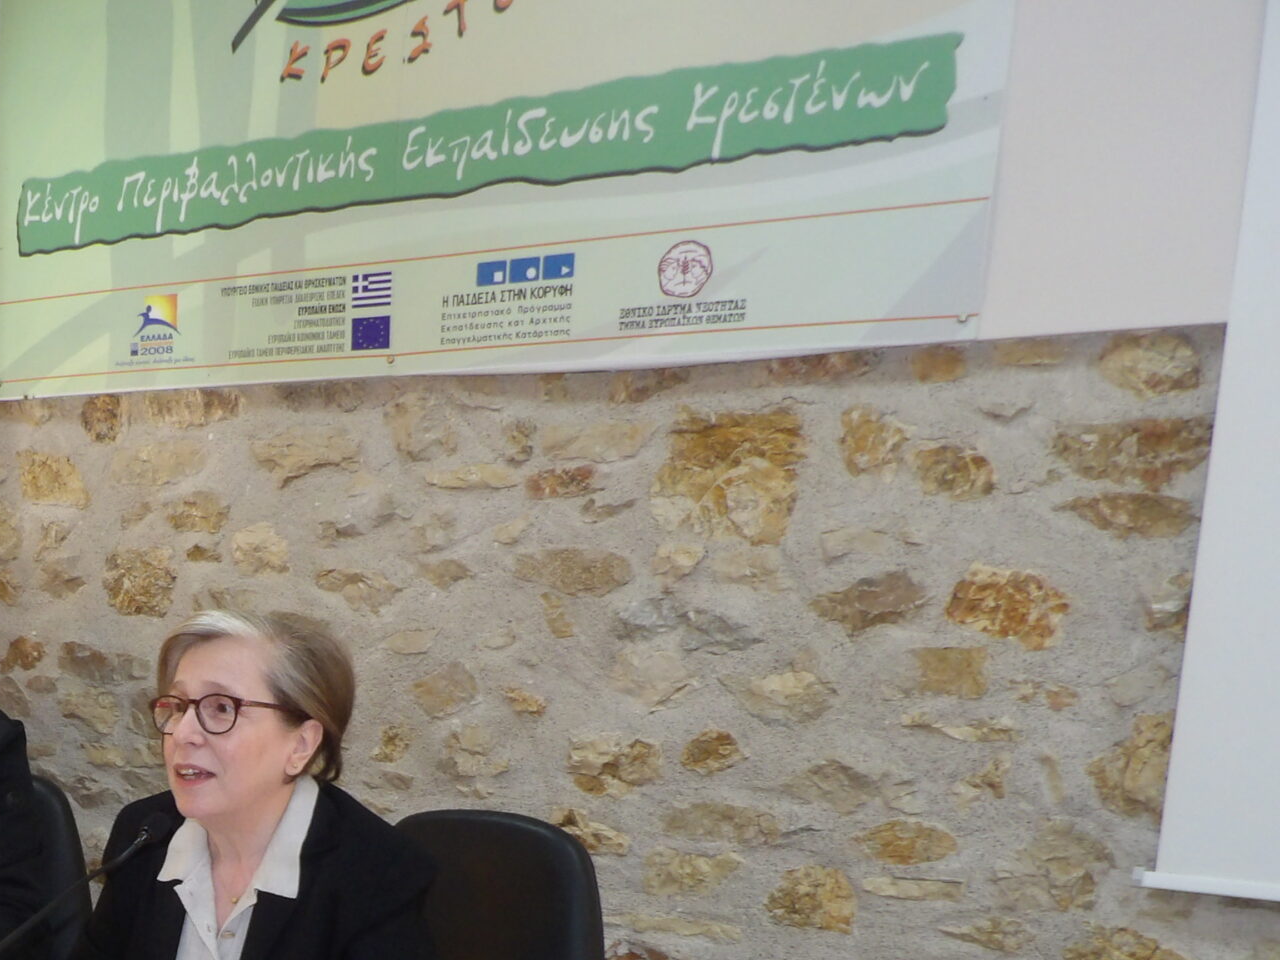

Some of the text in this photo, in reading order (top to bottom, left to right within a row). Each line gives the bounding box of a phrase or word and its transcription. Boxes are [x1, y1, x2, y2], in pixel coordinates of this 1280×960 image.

[23, 60, 931, 245] Κέντρο Περιβαλλοντικής Εκπαίδευσης Κρεστένων
[442, 284, 573, 308] Η ΠΑΙΔΕΙΑ ΣΤΗΝ ΚΟΡΥΦΗ
[441, 302, 573, 321] Επιχειρησιακό Πρόγραμμα
[619, 306, 654, 319] ΕΘΝΙΚΟ
[656, 303, 693, 316] ΙΔΡΥΜΑ
[140, 333, 174, 343] ΕΛΛΑΔΑ
[440, 327, 571, 346] Επαγγελματικής Κατάρτισης
[140, 345, 174, 356] 2008
